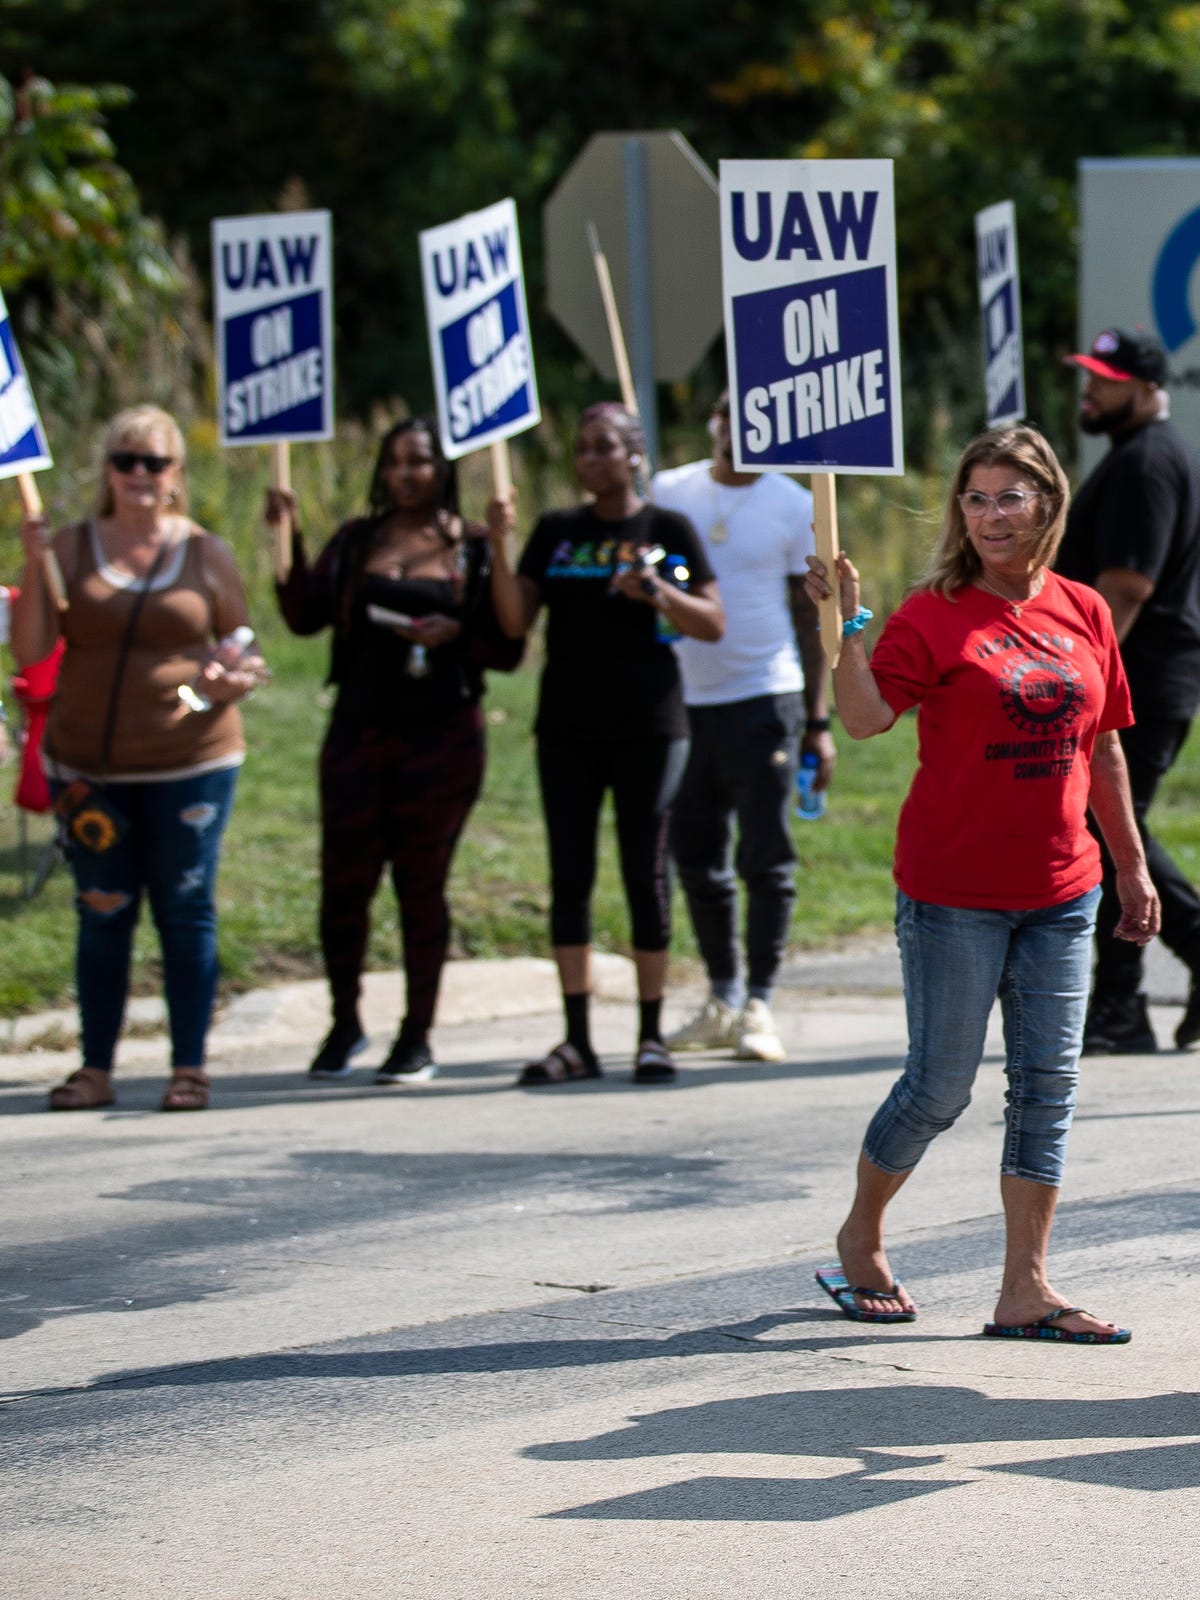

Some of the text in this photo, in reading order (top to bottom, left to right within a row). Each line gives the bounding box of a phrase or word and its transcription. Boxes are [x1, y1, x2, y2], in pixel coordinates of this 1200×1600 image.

[432, 226, 510, 297] UAW
[731, 190, 880, 262] UAW
[222, 236, 319, 290] UAW
[252, 306, 293, 367] ON
[465, 298, 505, 368] ON
[783, 288, 840, 367] ON
[228, 345, 323, 433] STRIKE
[449, 333, 529, 439] STRIKE
[744, 348, 886, 455] STRIKE
[1024, 680, 1058, 700] UAW
[985, 740, 1057, 761] COMMUNITY
